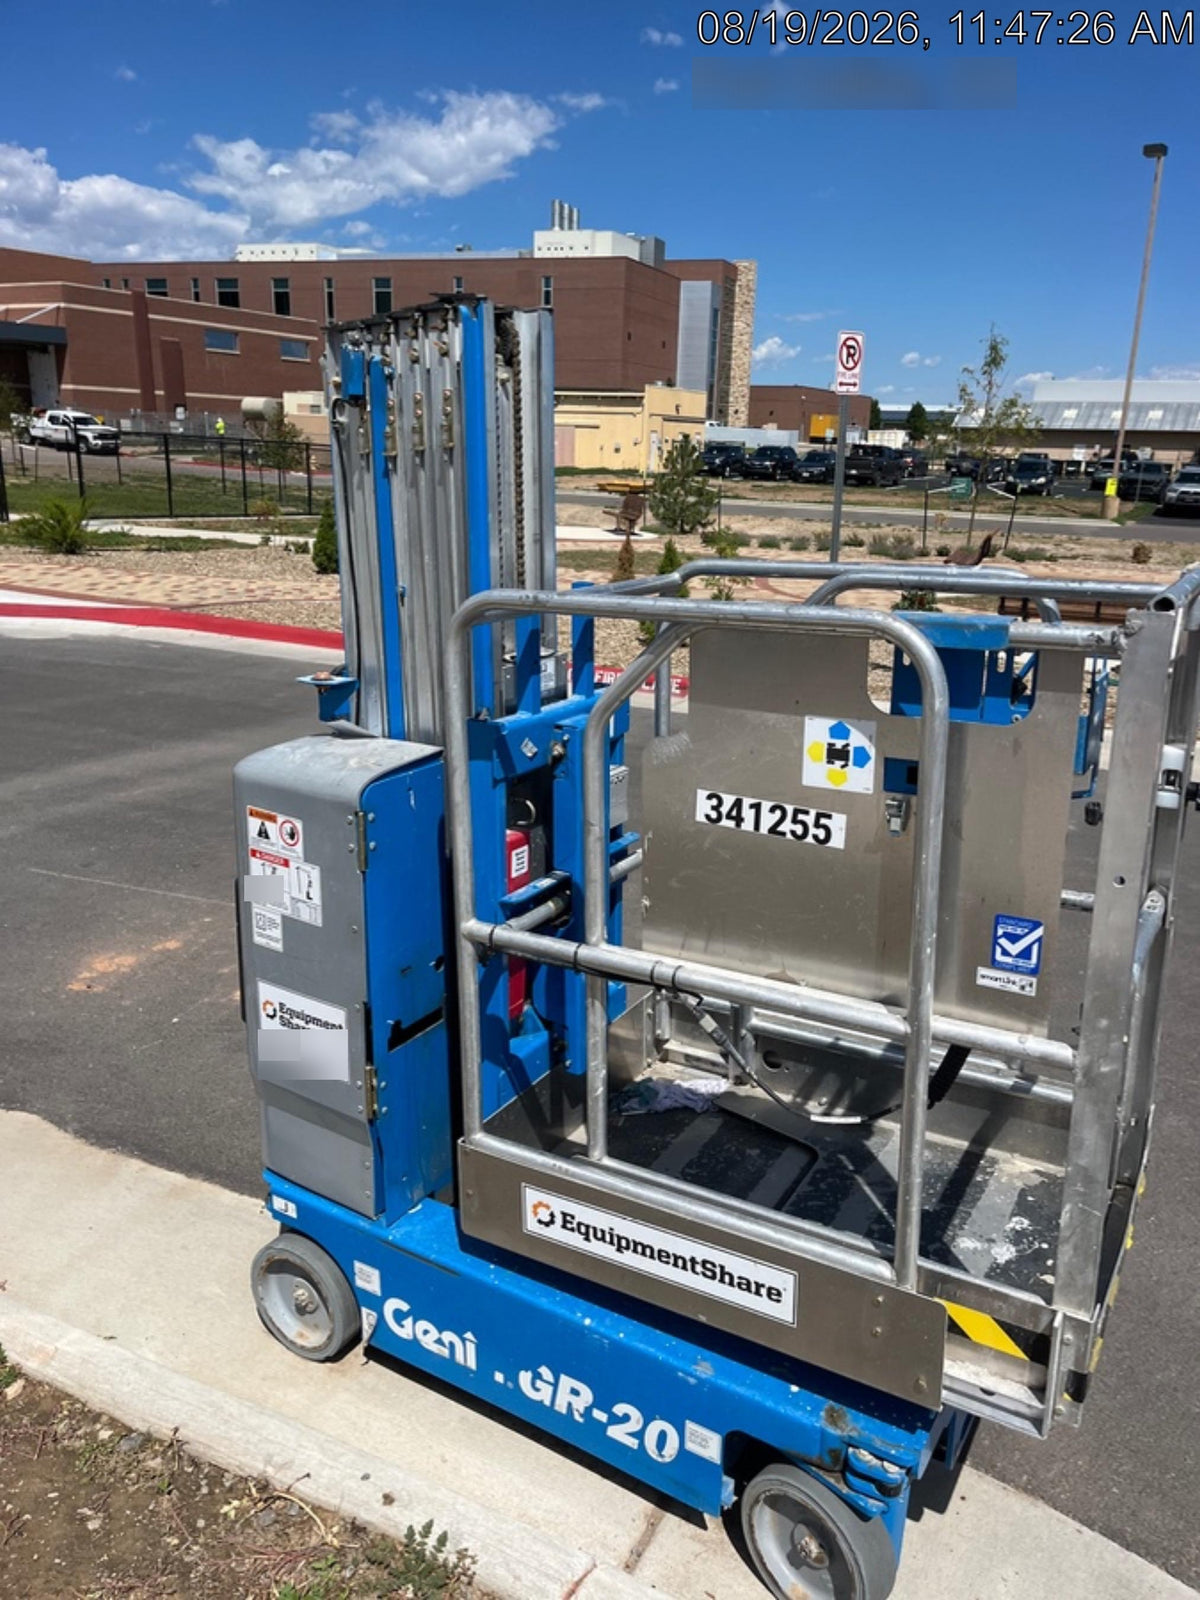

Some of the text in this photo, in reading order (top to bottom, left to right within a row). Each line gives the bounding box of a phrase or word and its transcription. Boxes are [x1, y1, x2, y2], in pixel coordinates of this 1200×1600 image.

[704, 792, 832, 845] 341255
[560, 1210, 783, 1304] EquipmentShare
[518, 1365, 680, 1463] GR-20
